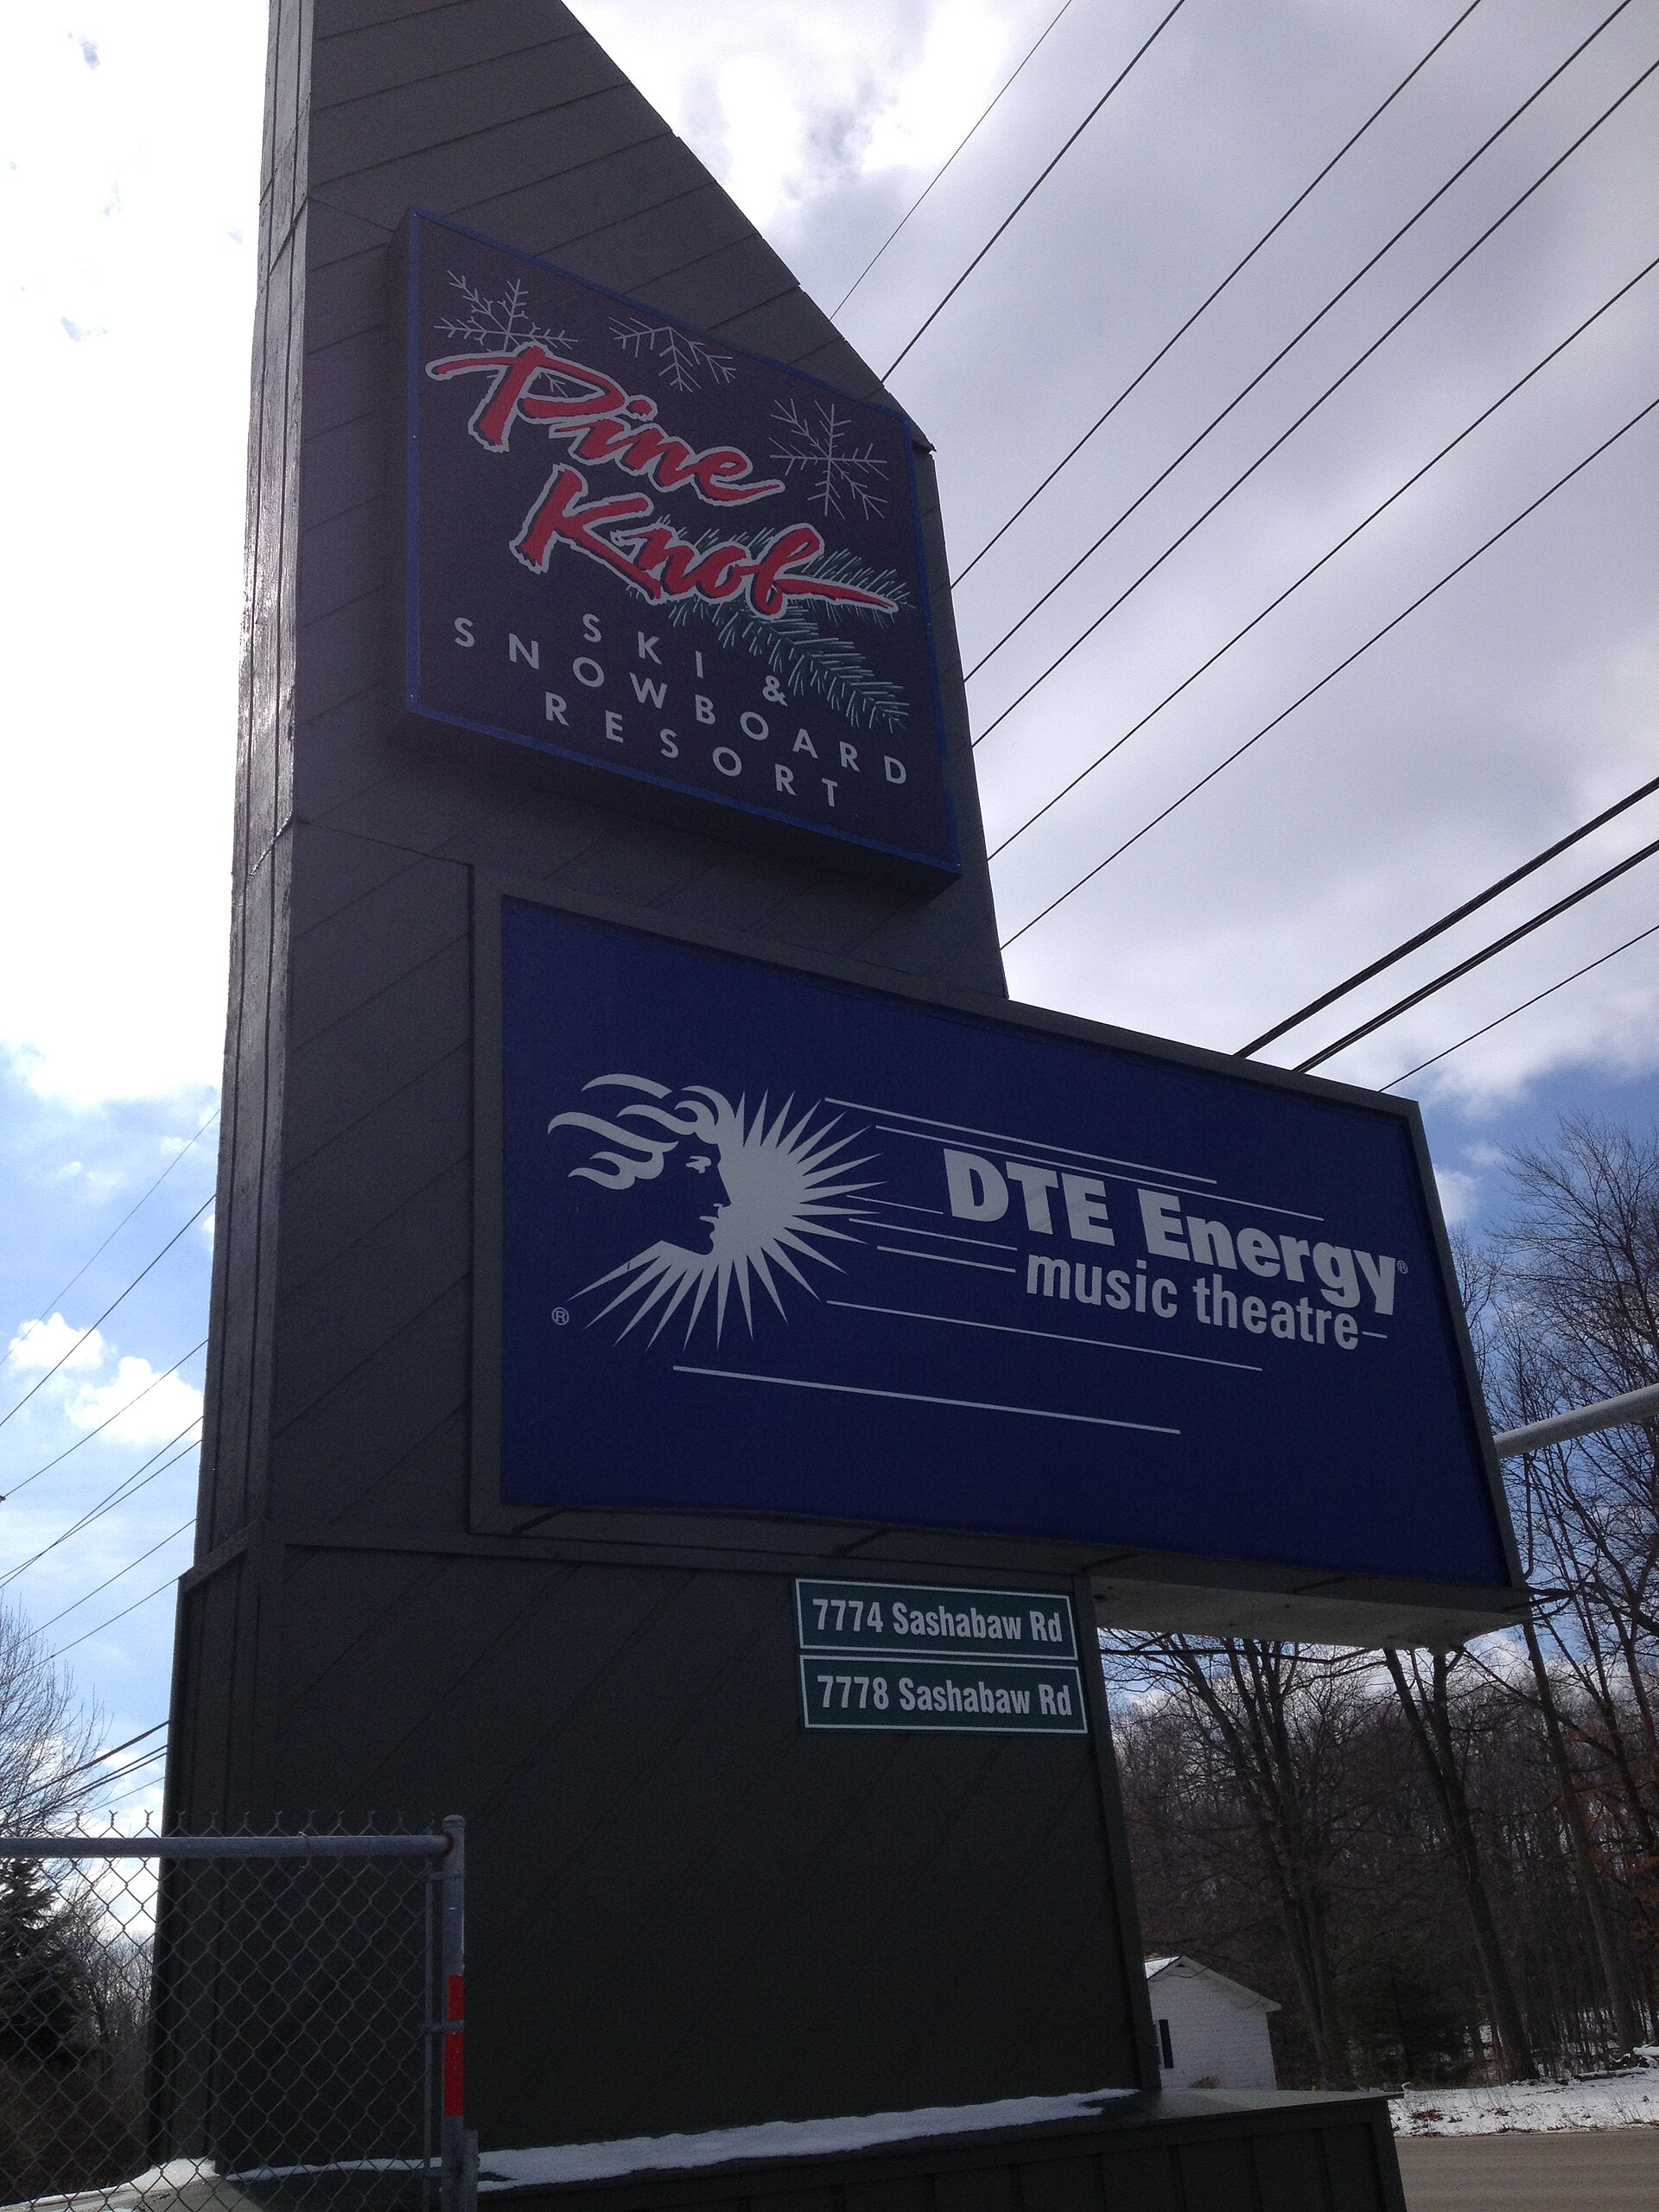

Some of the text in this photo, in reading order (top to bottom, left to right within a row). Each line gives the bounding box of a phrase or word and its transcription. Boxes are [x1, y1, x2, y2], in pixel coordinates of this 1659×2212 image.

[426, 342, 785, 507] Pine
[510, 463, 899, 620] Knob
[454, 617, 907, 785] SNOWBOARD
[582, 613, 788, 707] SKI &
[545, 691, 837, 808] RESORT
[943, 1147, 1116, 1247] DTE
[1027, 1253, 1359, 1351] music theatre
[812, 1599, 1063, 1643] 7774 Sashabaw Rd
[817, 1675, 1072, 1716] 7778 Sashabaw Rd
